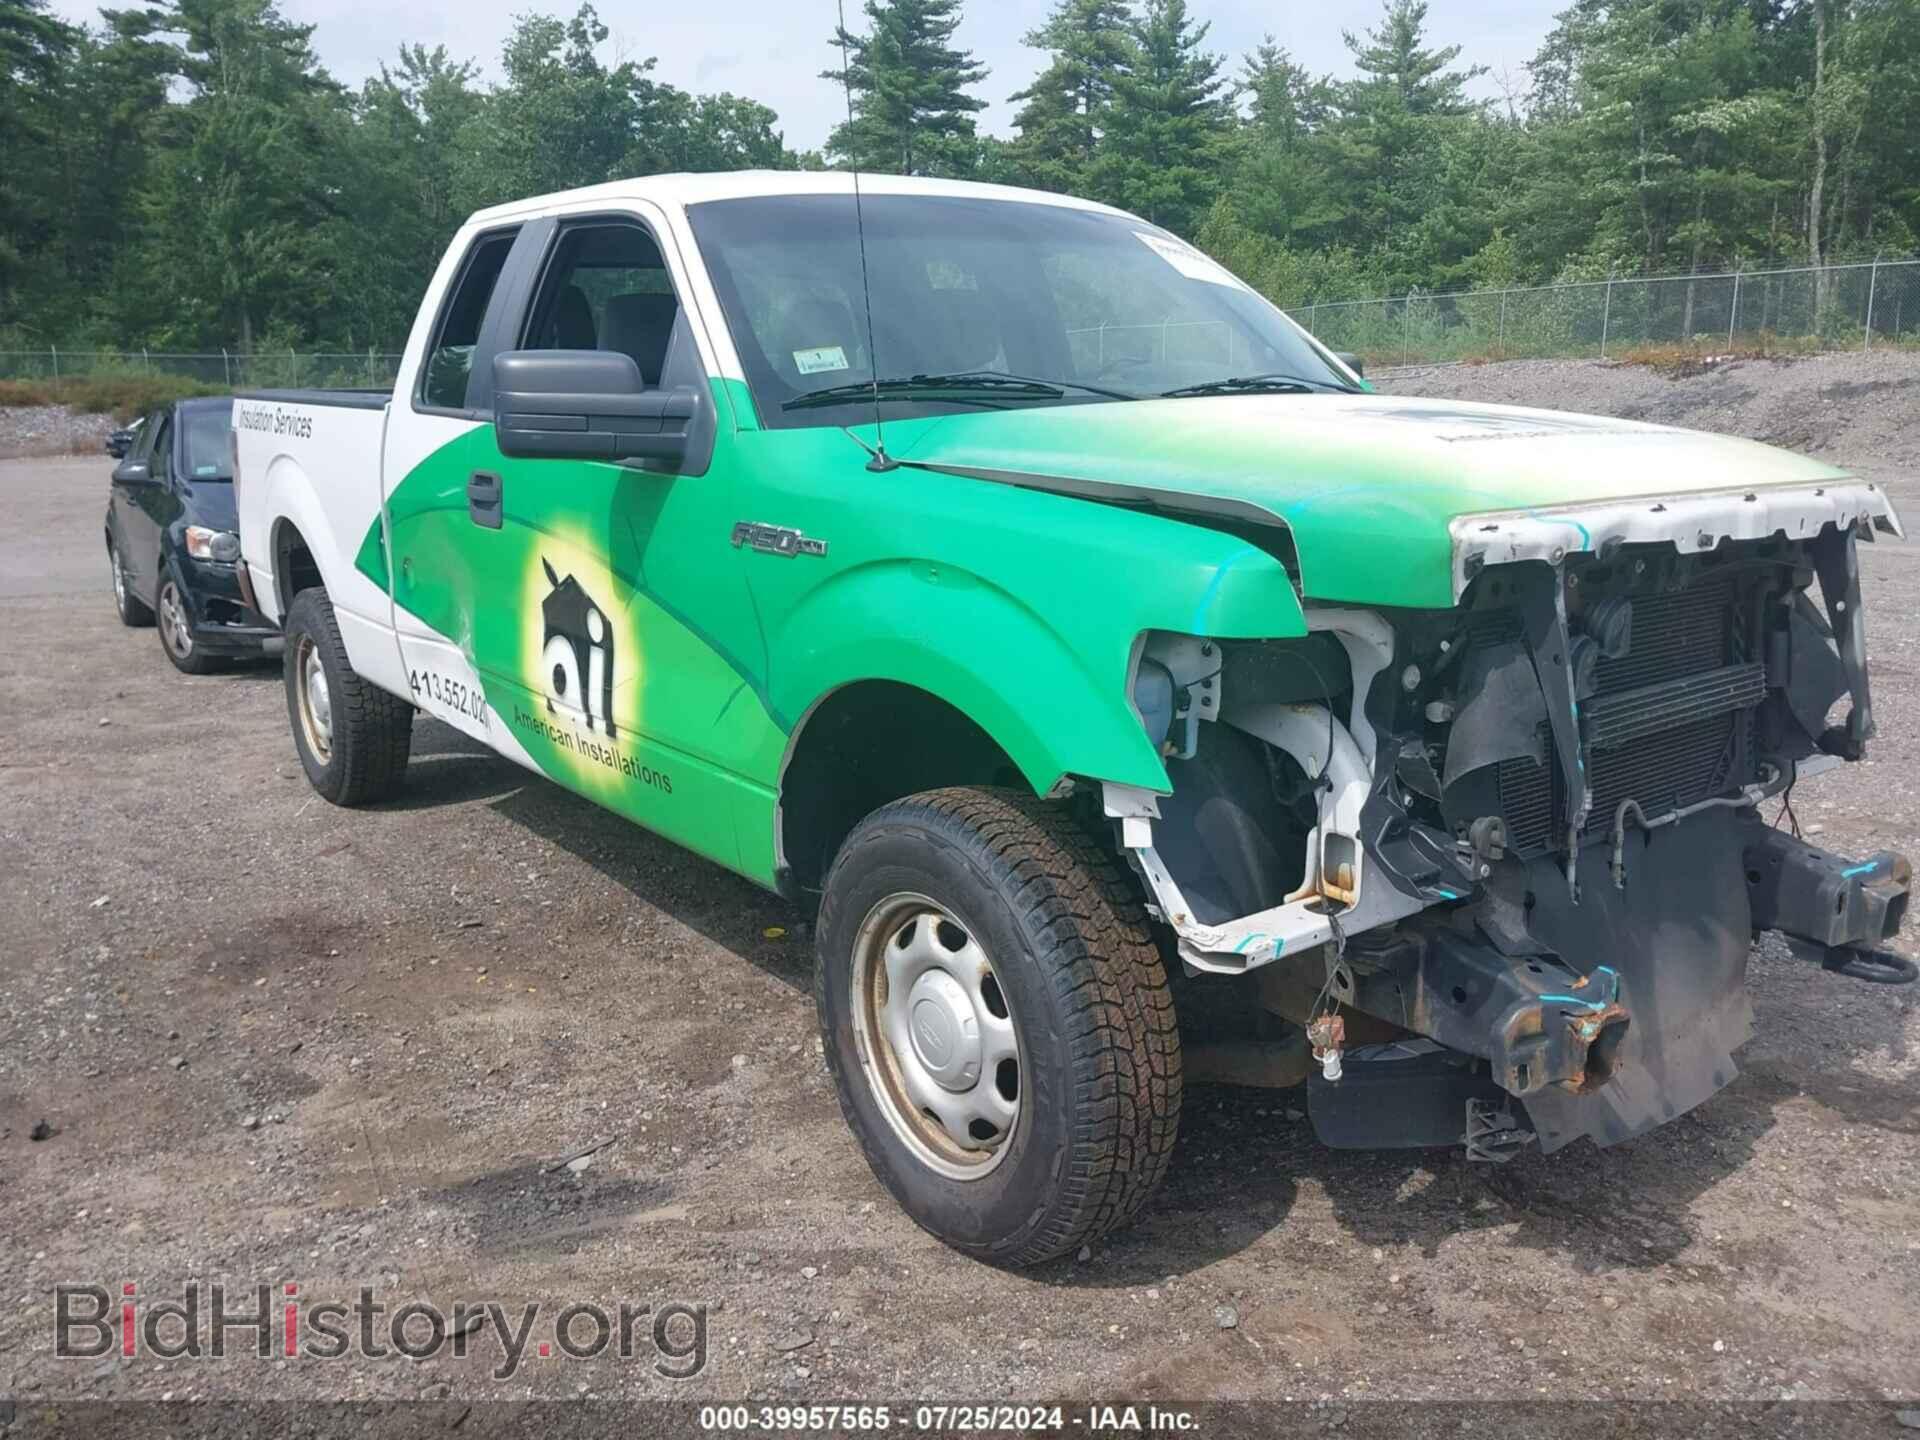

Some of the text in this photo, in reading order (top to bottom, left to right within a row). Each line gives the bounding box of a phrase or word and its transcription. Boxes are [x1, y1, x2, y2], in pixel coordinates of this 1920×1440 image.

[239, 403, 313, 438] Insulation Services
[410, 669, 493, 733] 413.552.02
[514, 704, 673, 794] American Installations
